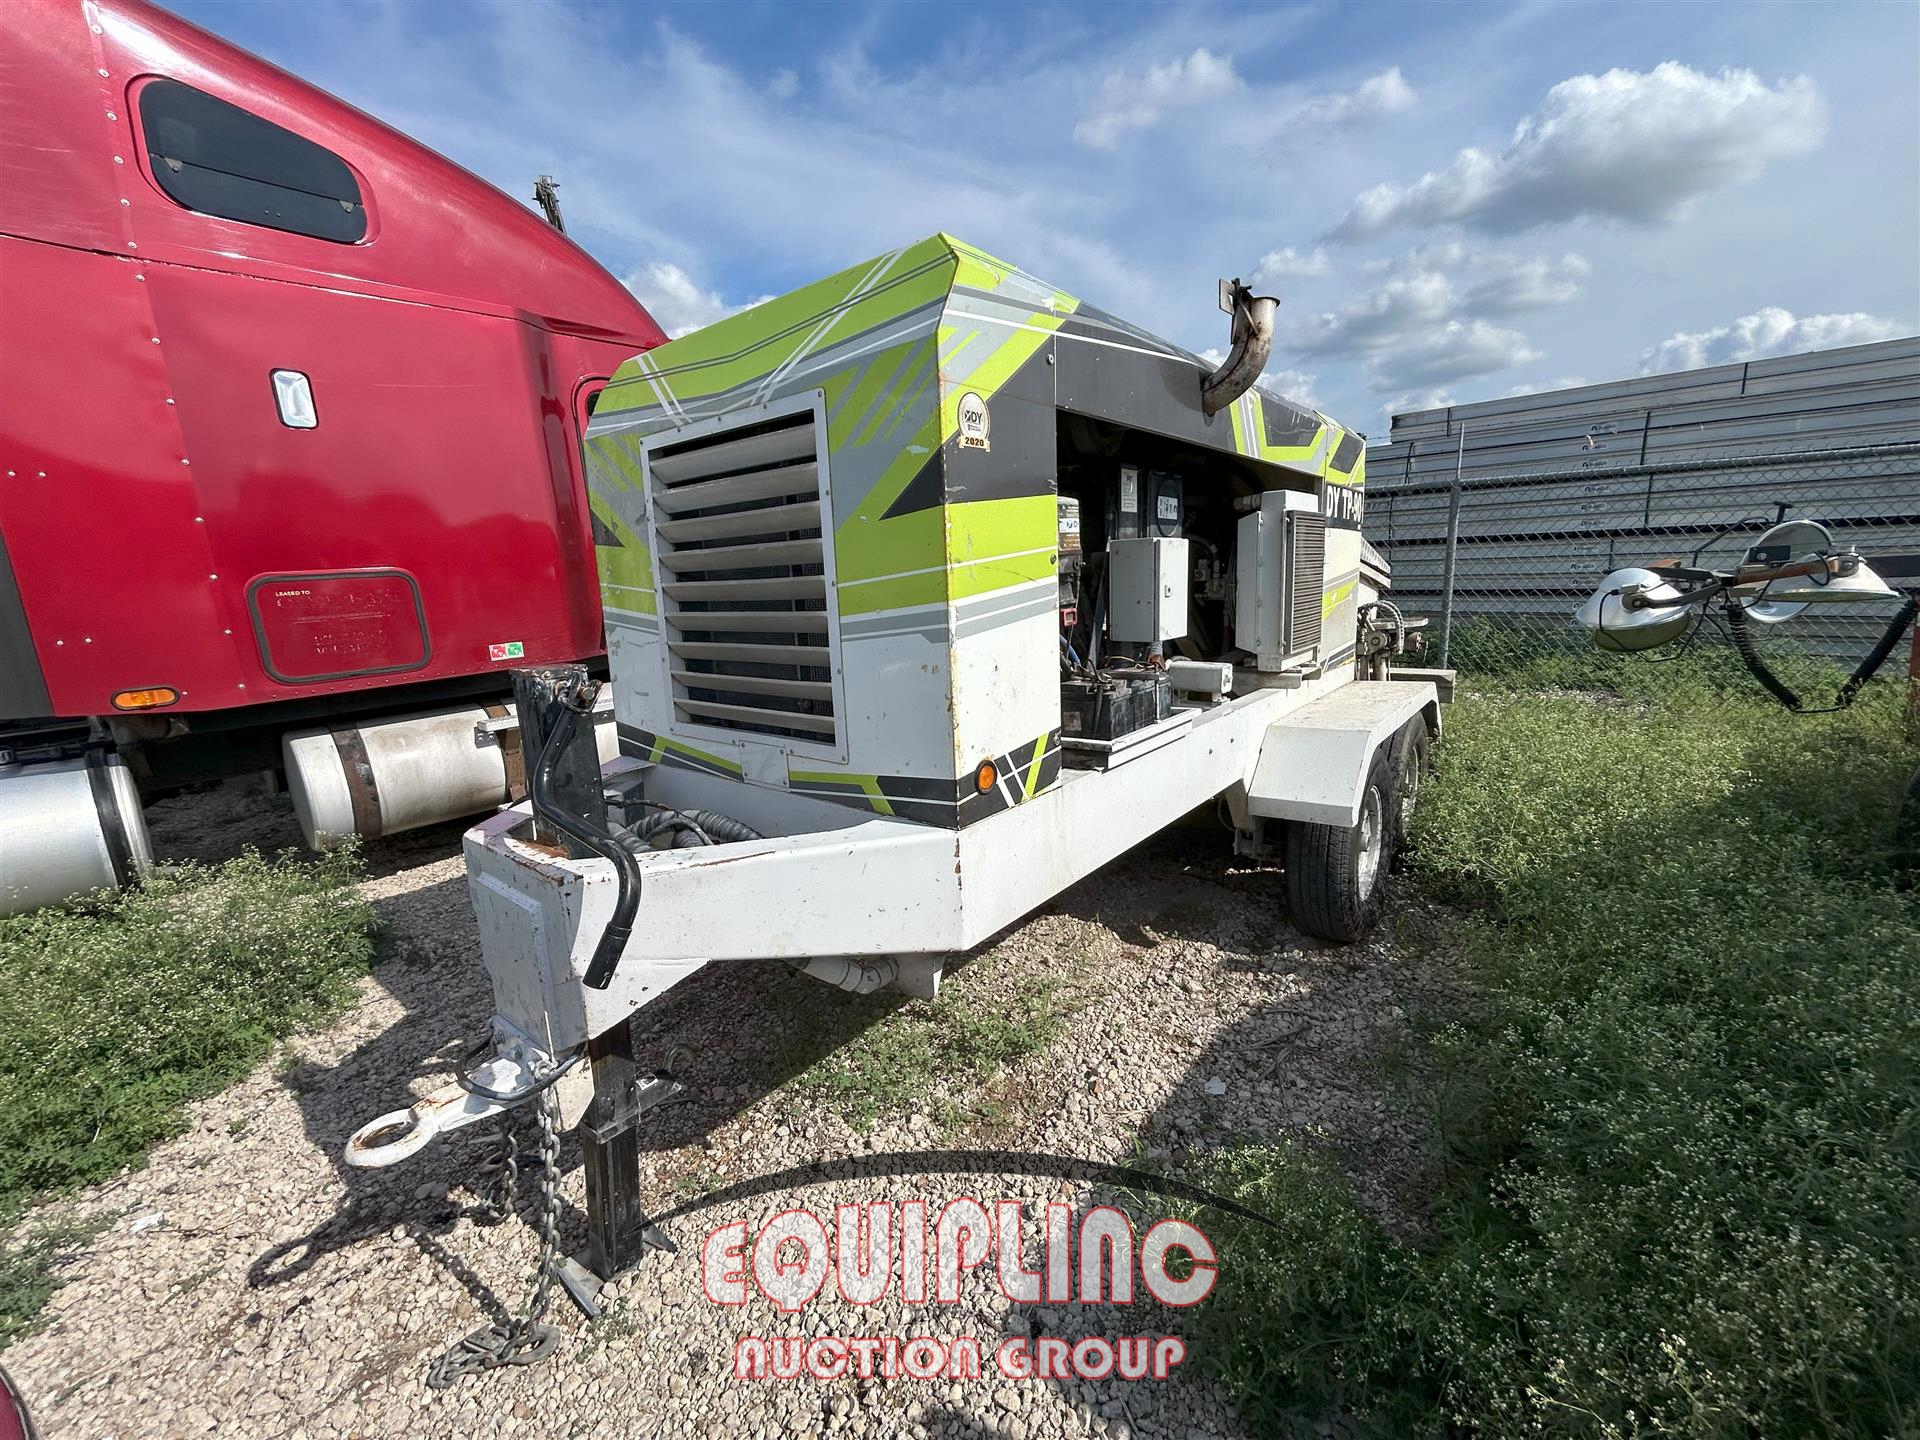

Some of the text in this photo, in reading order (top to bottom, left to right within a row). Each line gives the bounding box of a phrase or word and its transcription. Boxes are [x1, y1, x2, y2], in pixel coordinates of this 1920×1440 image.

[972, 411, 982, 424] DY
[965, 436, 984, 446] 2020
[1326, 485, 1340, 518] DY
